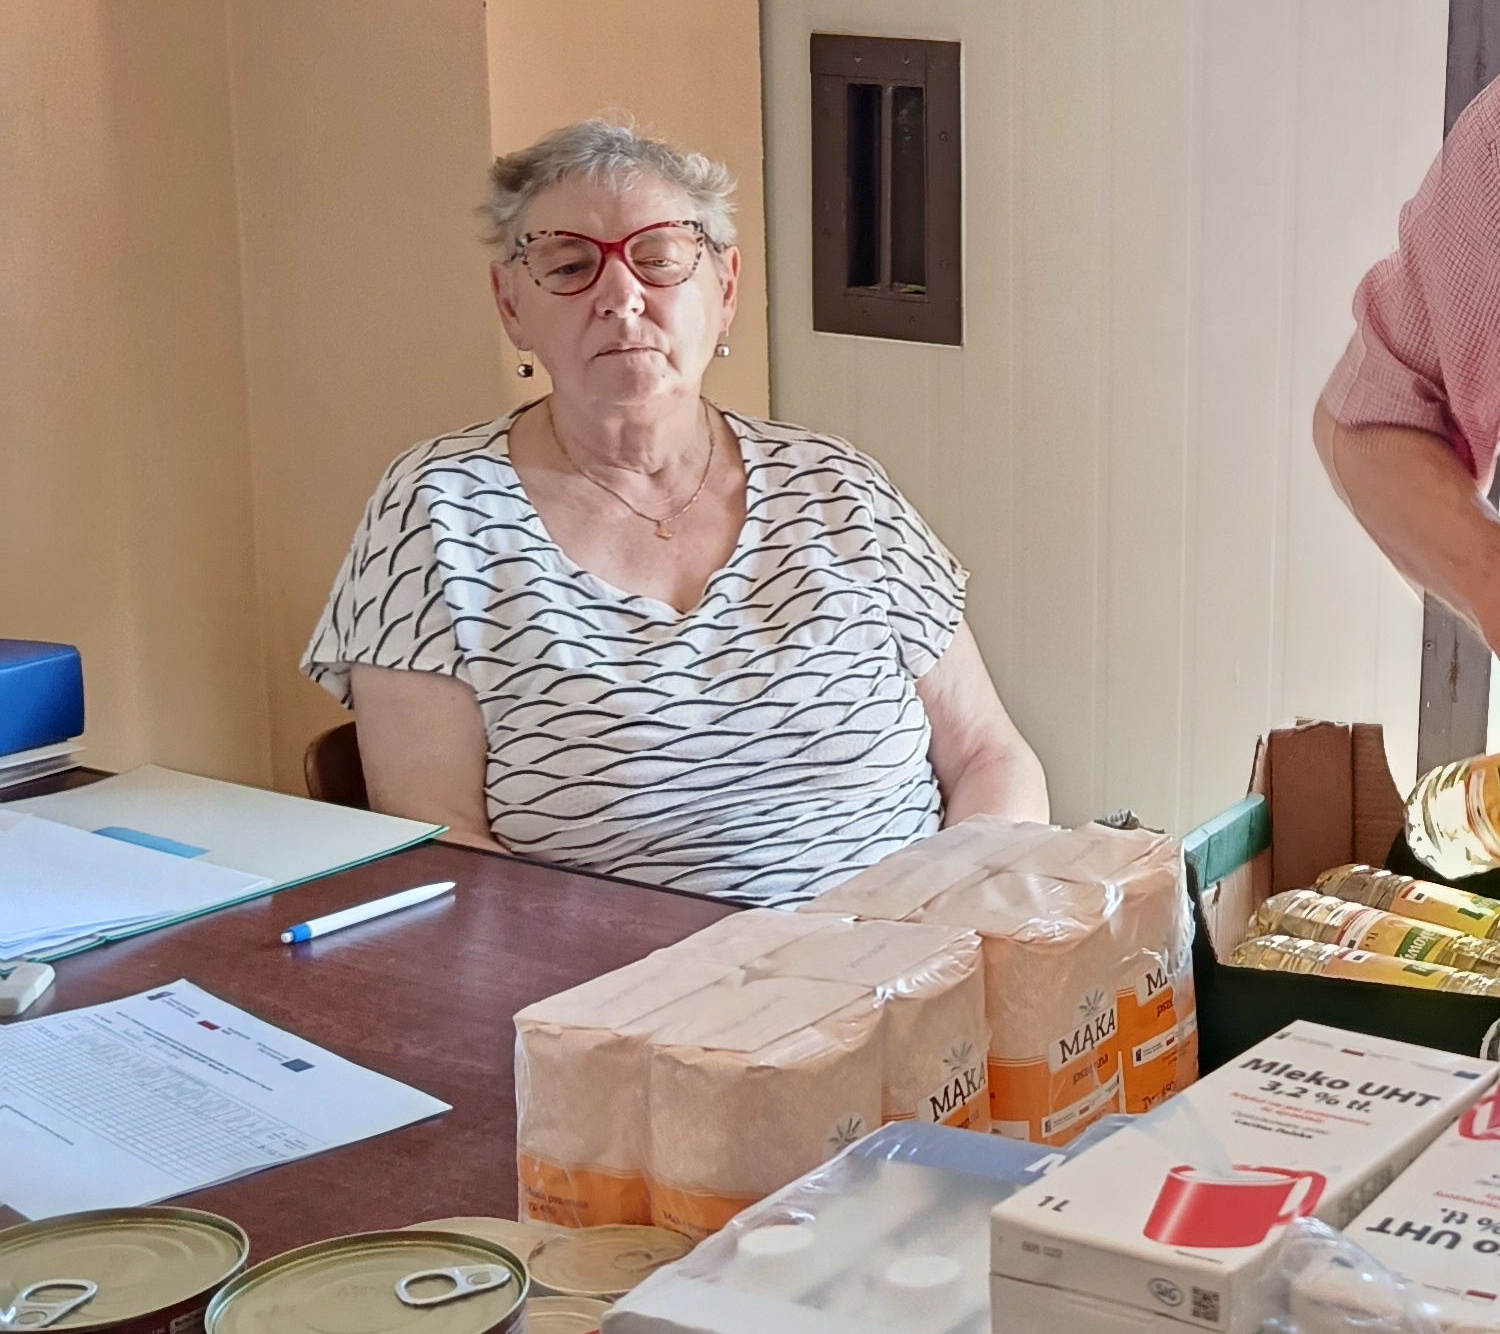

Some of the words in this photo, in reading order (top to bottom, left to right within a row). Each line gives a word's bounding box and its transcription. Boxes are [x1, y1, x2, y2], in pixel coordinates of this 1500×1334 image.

[1238, 1057, 1350, 1091] Mleko
[1356, 1081, 1442, 1108] UHT
[1258, 1079, 1309, 1099] 3,2
[1314, 1090, 1341, 1107] %
[1364, 1216, 1463, 1250] UHT
